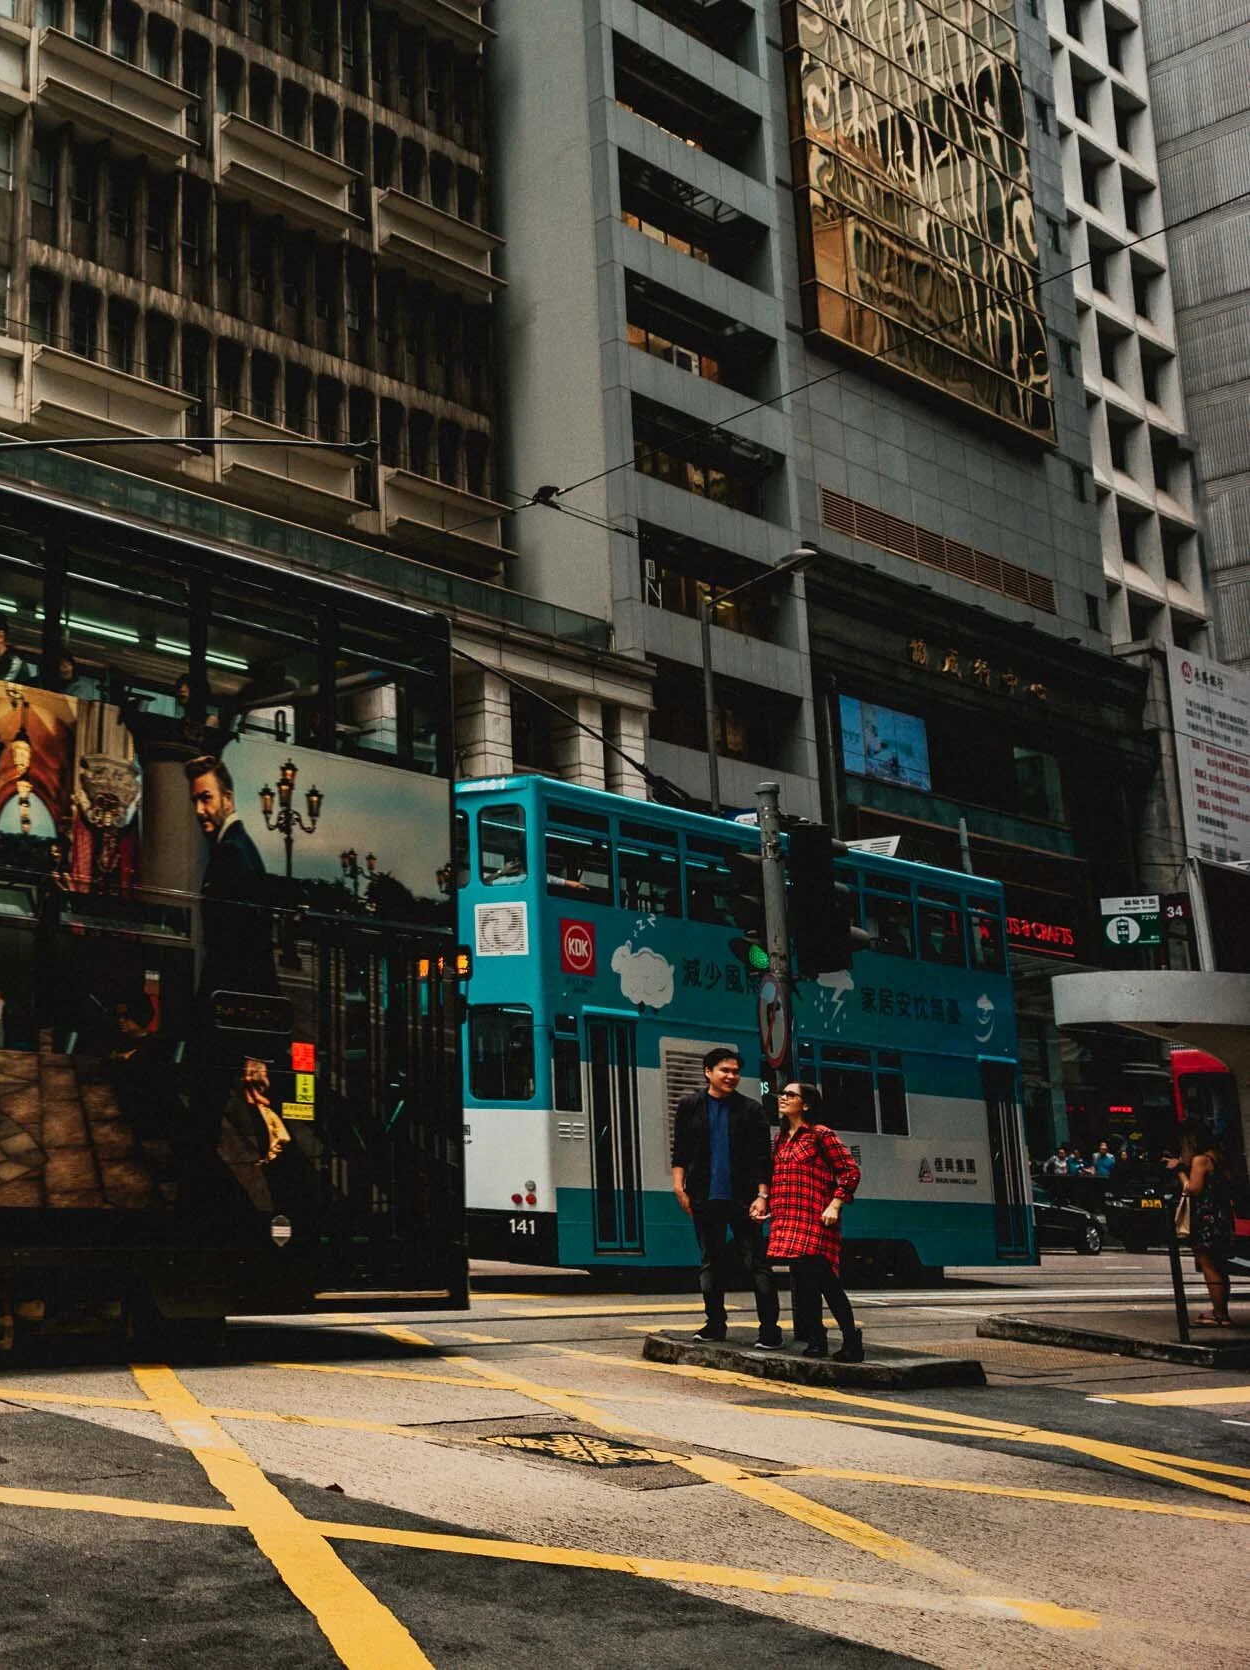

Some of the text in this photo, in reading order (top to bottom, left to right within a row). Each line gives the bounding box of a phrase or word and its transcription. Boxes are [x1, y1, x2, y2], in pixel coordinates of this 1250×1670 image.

[1166, 905, 1183, 918] 34
[1031, 921, 1075, 945] CRAFTS
[568, 938, 588, 958] KDK
[509, 1218, 535, 1234] 141
